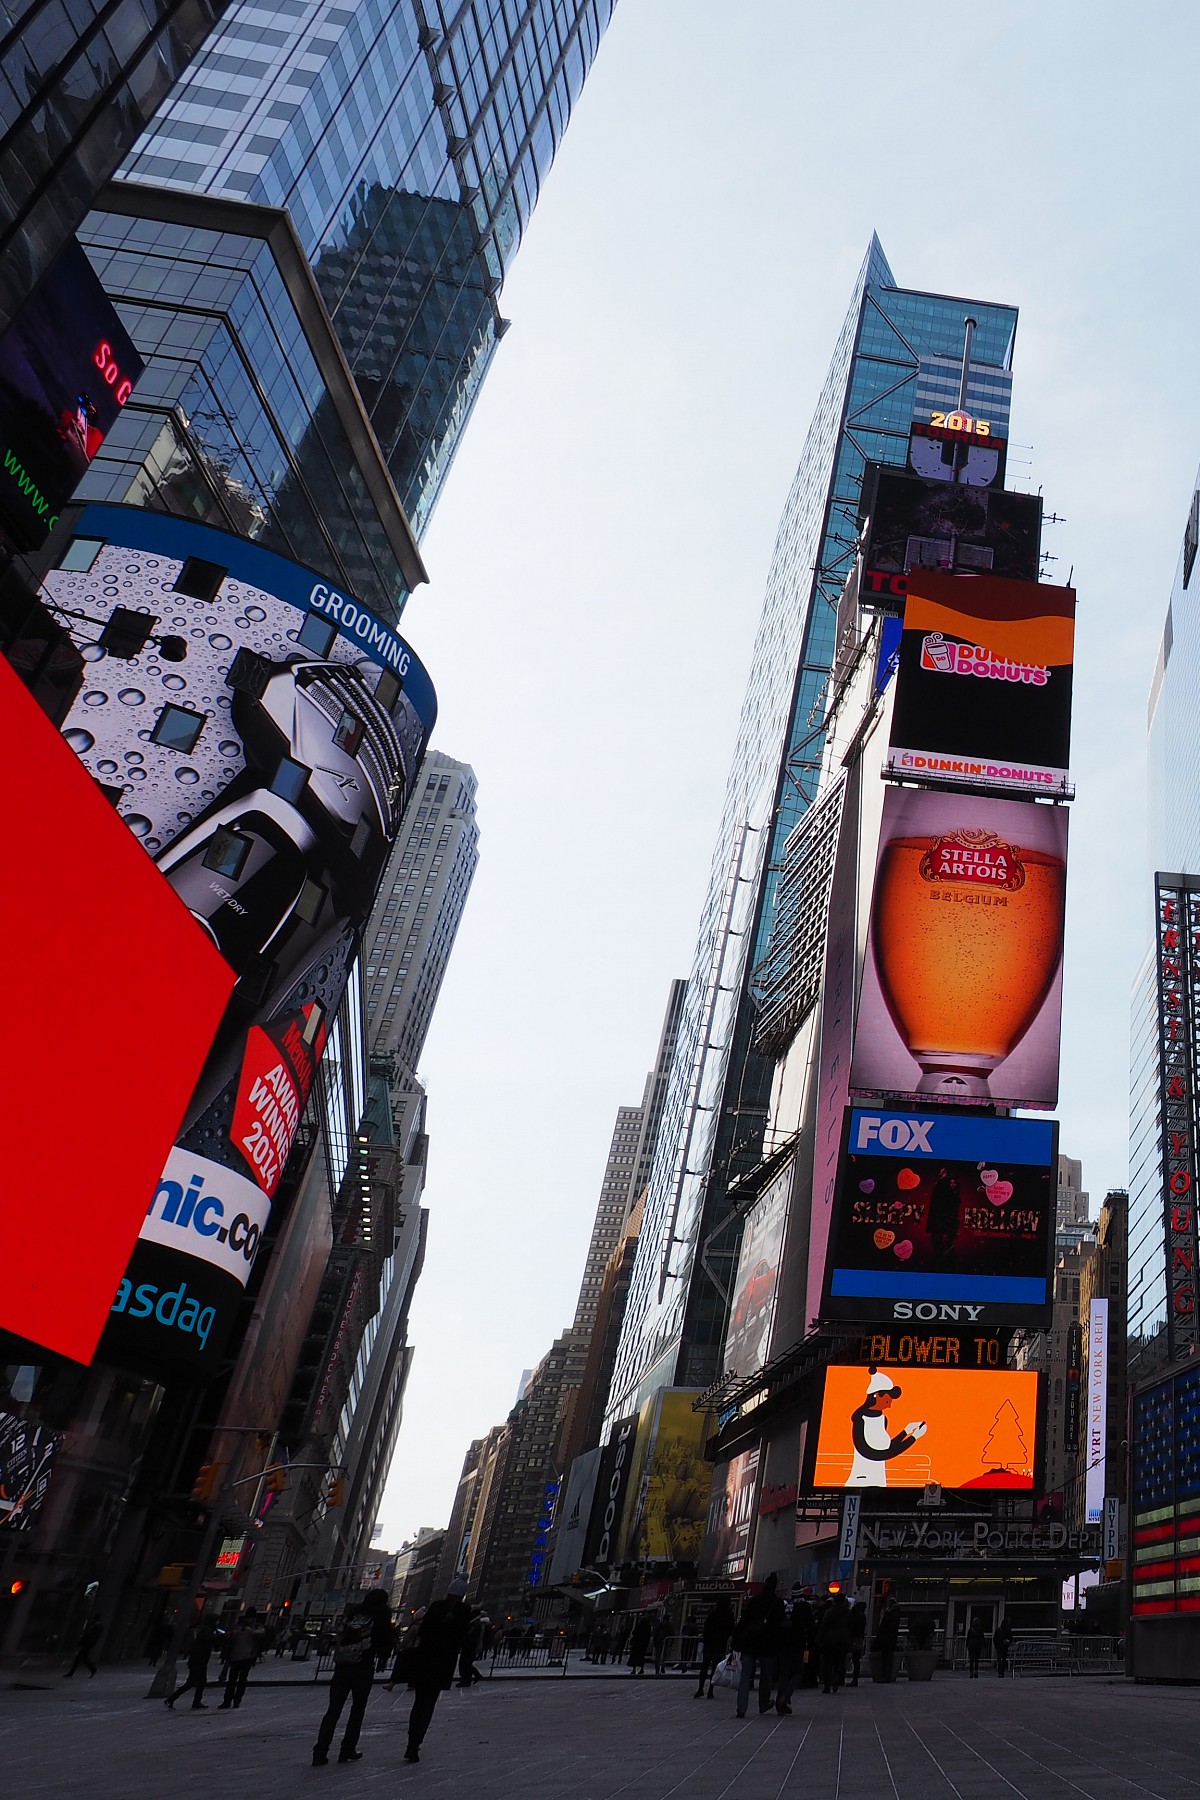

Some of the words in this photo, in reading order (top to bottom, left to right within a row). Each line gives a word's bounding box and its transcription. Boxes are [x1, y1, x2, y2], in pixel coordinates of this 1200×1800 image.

[914, 425, 1004, 450] TOSHIBA
[930, 411, 990, 436] 2015
[309, 583, 411, 676] GROOMING
[957, 659, 1047, 684] DONUTS
[914, 756, 986, 775] DUNKIN'
[987, 765, 1053, 783] DONUTS
[938, 862, 1007, 880] ARTOIS
[940, 848, 1007, 867] STELLA
[208, 881, 249, 916] WET/DRY
[929, 889, 1009, 907] BELGIUM
[265, 1063, 299, 1148] AWAR
[856, 1116, 935, 1153] FOX
[242, 1121, 278, 1190] 2014
[852, 1200, 925, 1226] SLEEPY
[963, 1206, 1041, 1232] HOLLOW
[893, 1302, 986, 1321] SONY
[1094, 1313, 1103, 1343] REIT
[974, 1338, 1000, 1365] TO
[1093, 1354, 1103, 1394] YORK
[1092, 1397, 1102, 1423] NEW
[1091, 1428, 1102, 1467] NYRT
[843, 1498, 857, 1558] NYPD
[1107, 1499, 1116, 1558] NYPD
